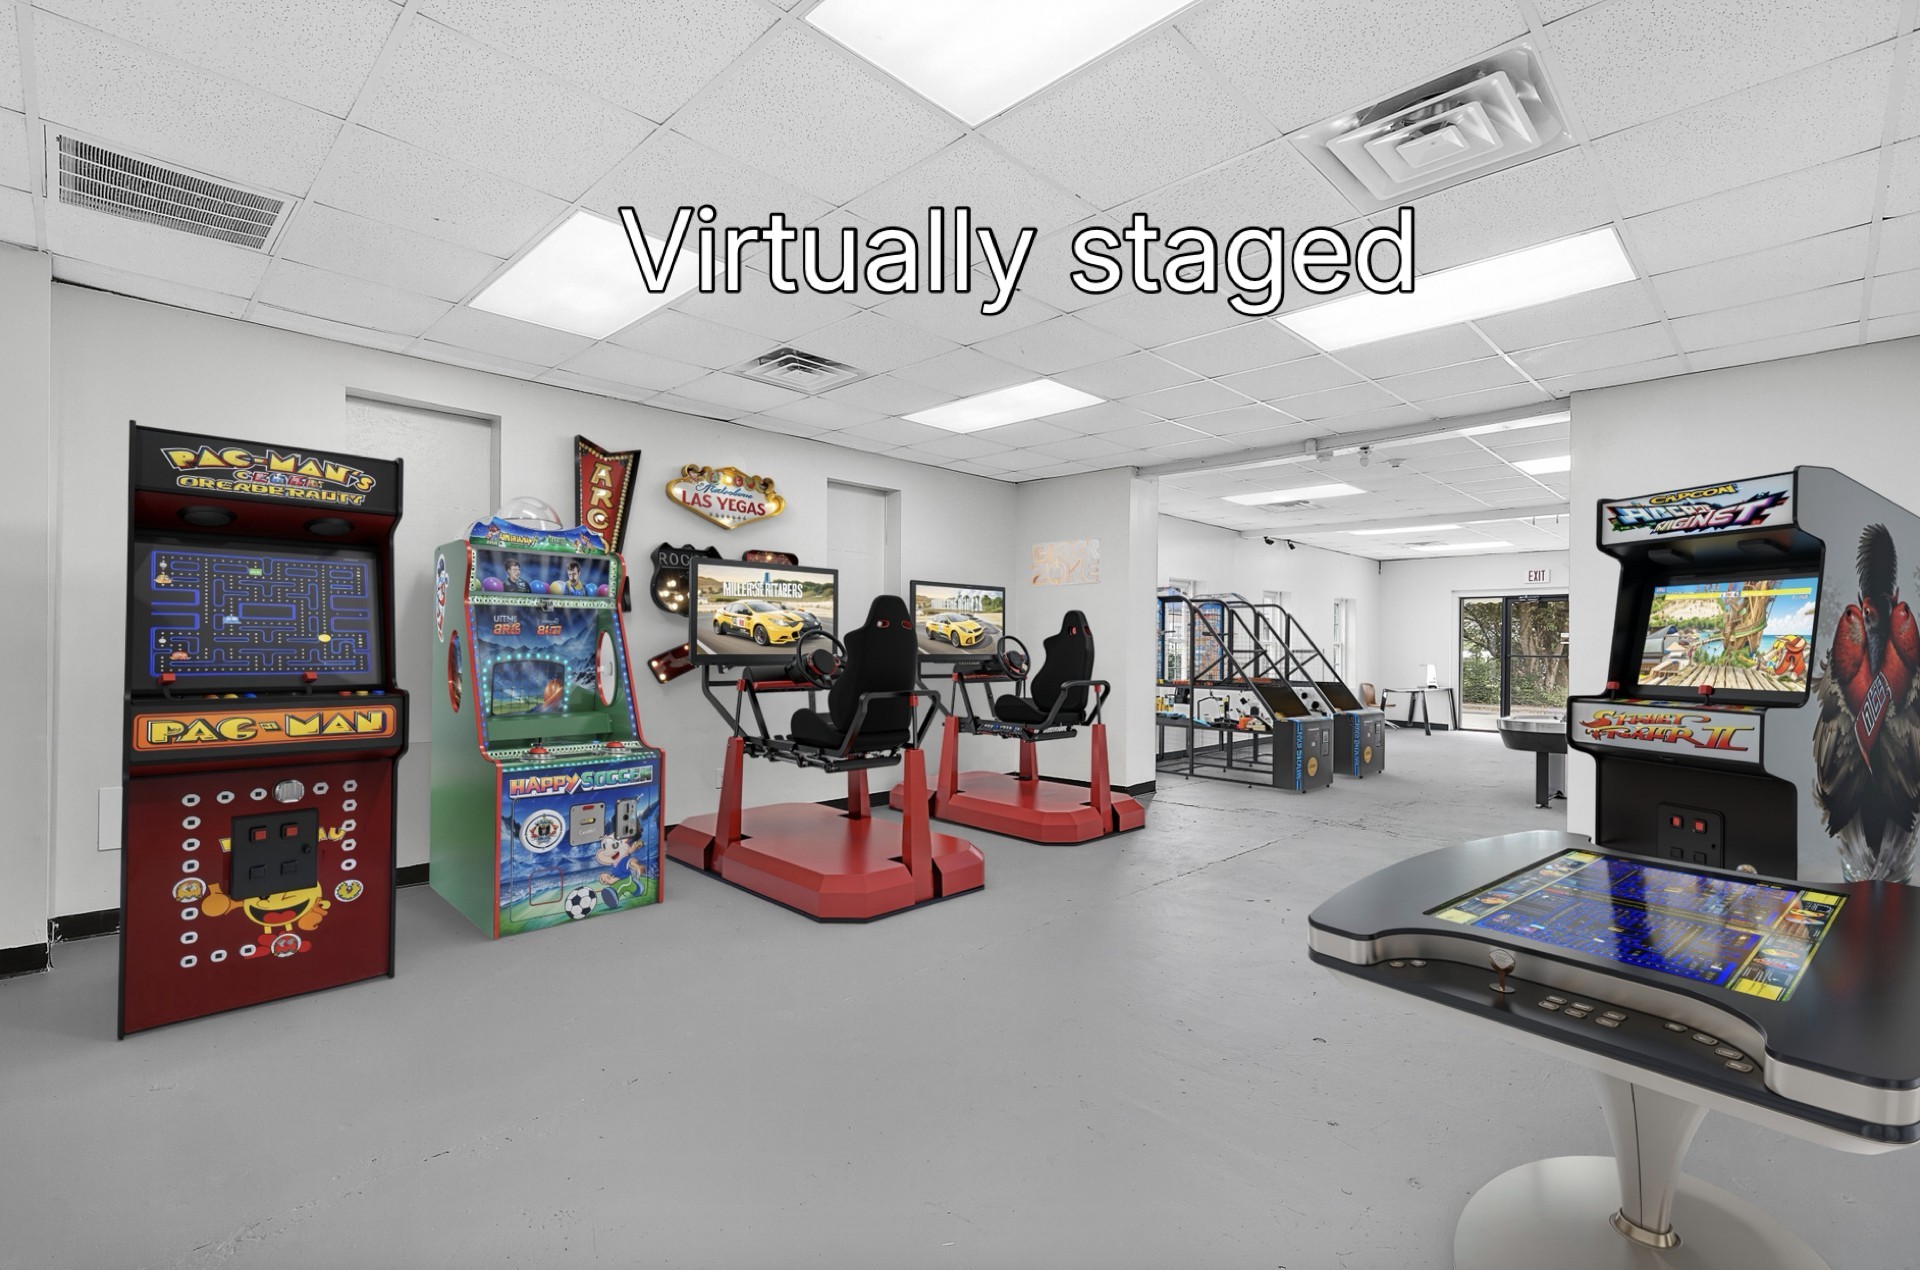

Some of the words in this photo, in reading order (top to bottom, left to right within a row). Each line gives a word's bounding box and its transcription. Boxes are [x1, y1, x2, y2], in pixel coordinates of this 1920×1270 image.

[160, 445, 376, 492] PAC-MAN'S
[681, 490, 712, 508] LAS
[658, 551, 692, 567] ROC
[1528, 570, 1546, 582] EXIT
[147, 710, 387, 745] PAC-MAN
[509, 772, 581, 798] HAPPY
